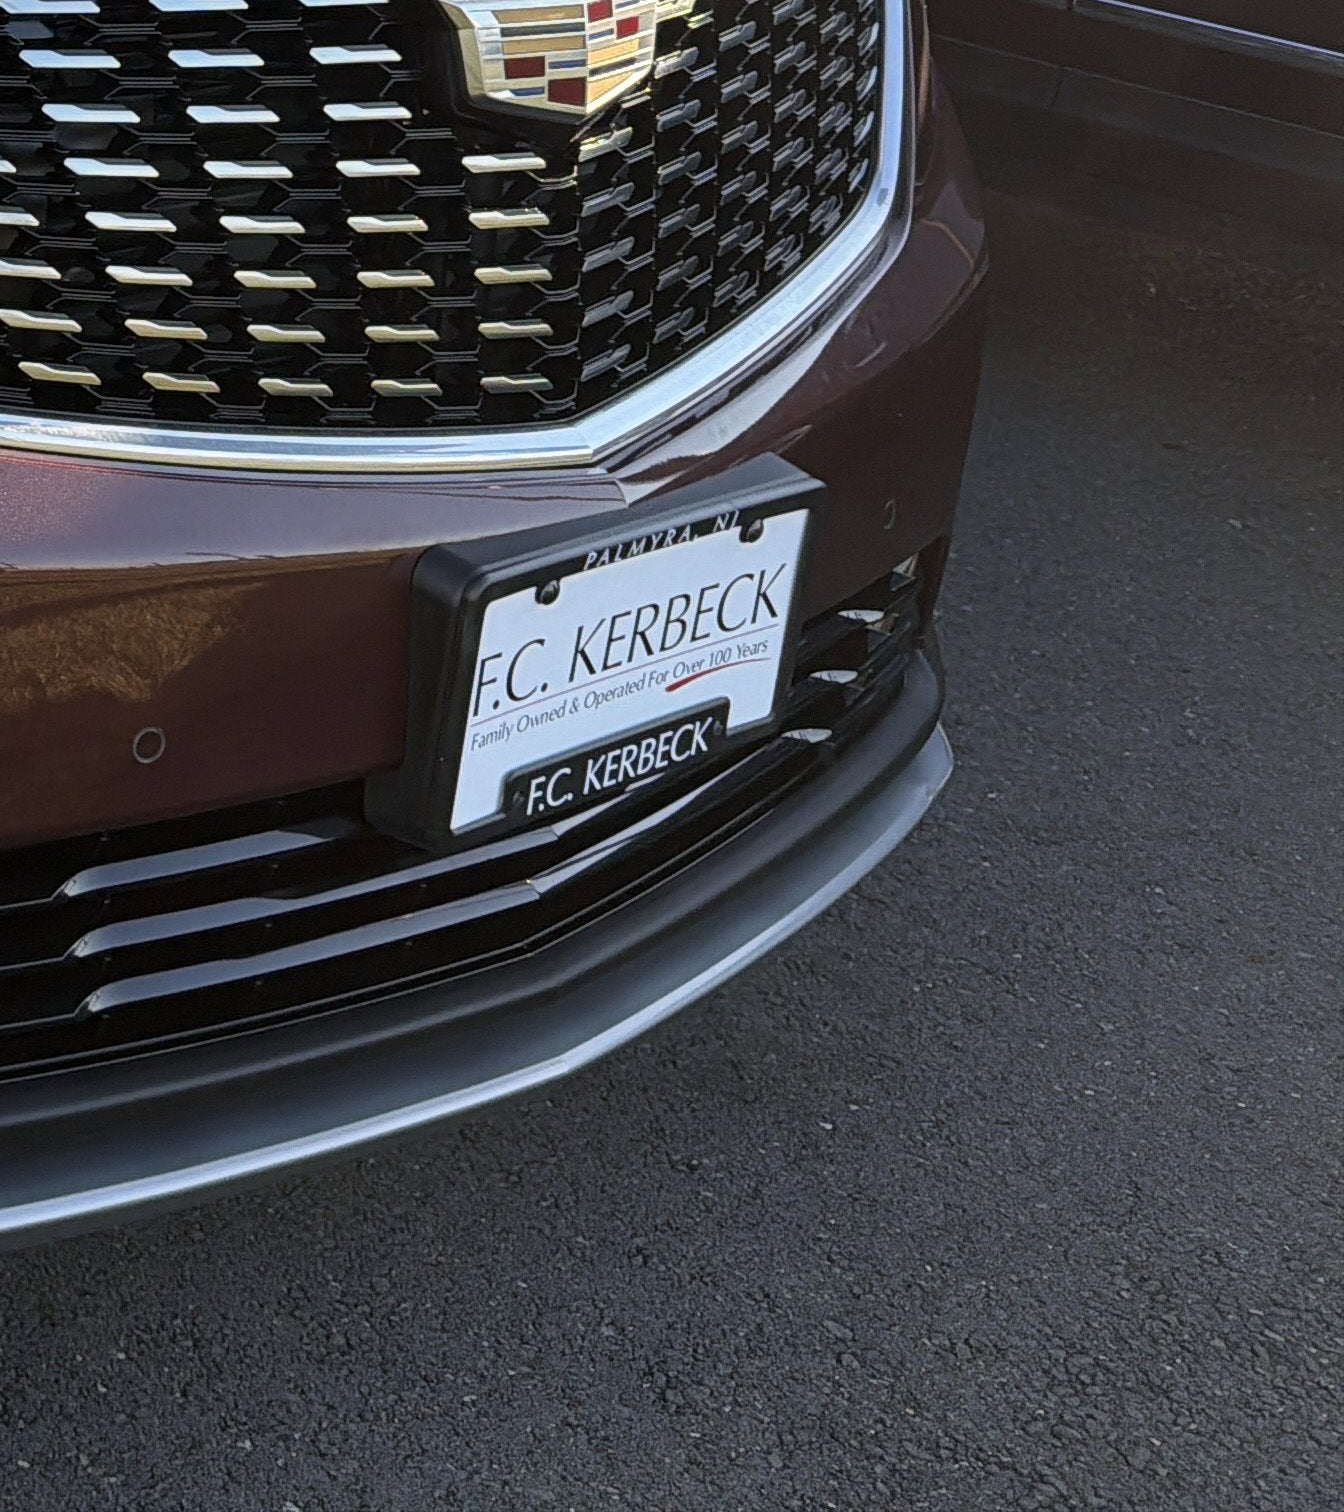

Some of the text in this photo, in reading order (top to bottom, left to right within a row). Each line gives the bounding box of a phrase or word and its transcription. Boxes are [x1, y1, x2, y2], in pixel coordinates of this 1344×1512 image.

[471, 638, 769, 752] Family Owned & Operated For Over 100 Years
[473, 562, 787, 718] F.C. KERBECK
[526, 716, 714, 817] F.C. KERBECK
